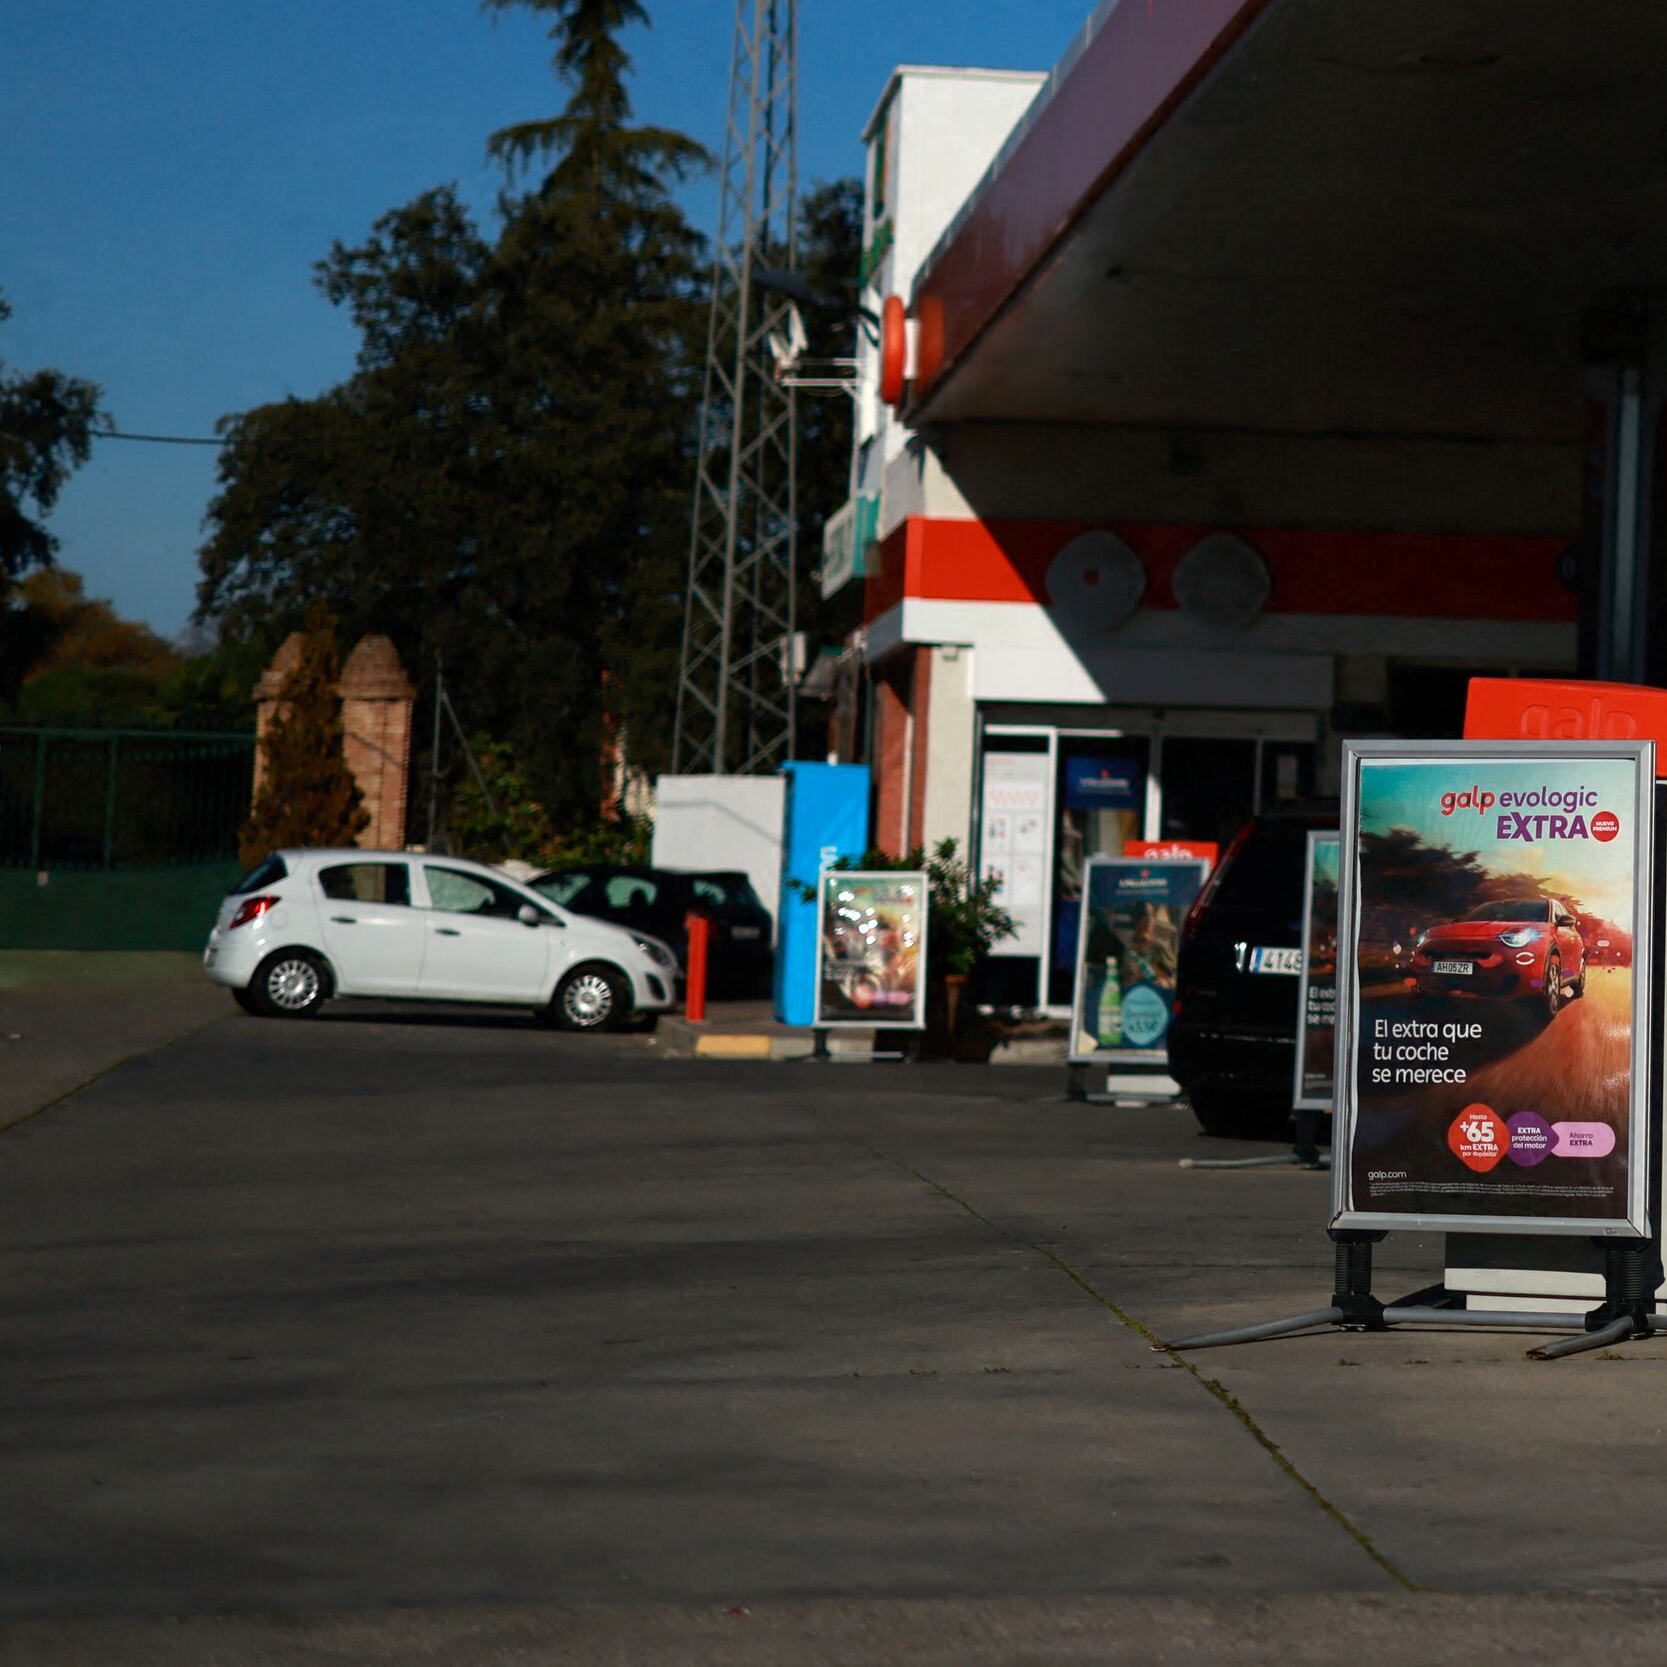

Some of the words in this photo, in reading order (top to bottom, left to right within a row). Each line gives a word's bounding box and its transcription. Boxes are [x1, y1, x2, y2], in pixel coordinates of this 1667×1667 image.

[1519, 695, 1638, 740] galp
[1440, 785, 1496, 816] galp
[1499, 785, 1598, 814] evologic
[1496, 812, 1589, 842] EXTRA
[1374, 1019, 1388, 1038] El
[1392, 1019, 1439, 1038] extra
[1442, 1023, 1483, 1043] que
[1373, 1042, 1392, 1061] tu
[1396, 1042, 1449, 1061] coche
[1372, 1068, 1391, 1083] se
[1395, 1068, 1466, 1083] merece
[1460, 1121, 1495, 1143] +65
[1511, 1134, 1547, 1143] protección
[1472, 1143, 1499, 1151] EXTRA
[1367, 1170, 1407, 1180] galp.com
